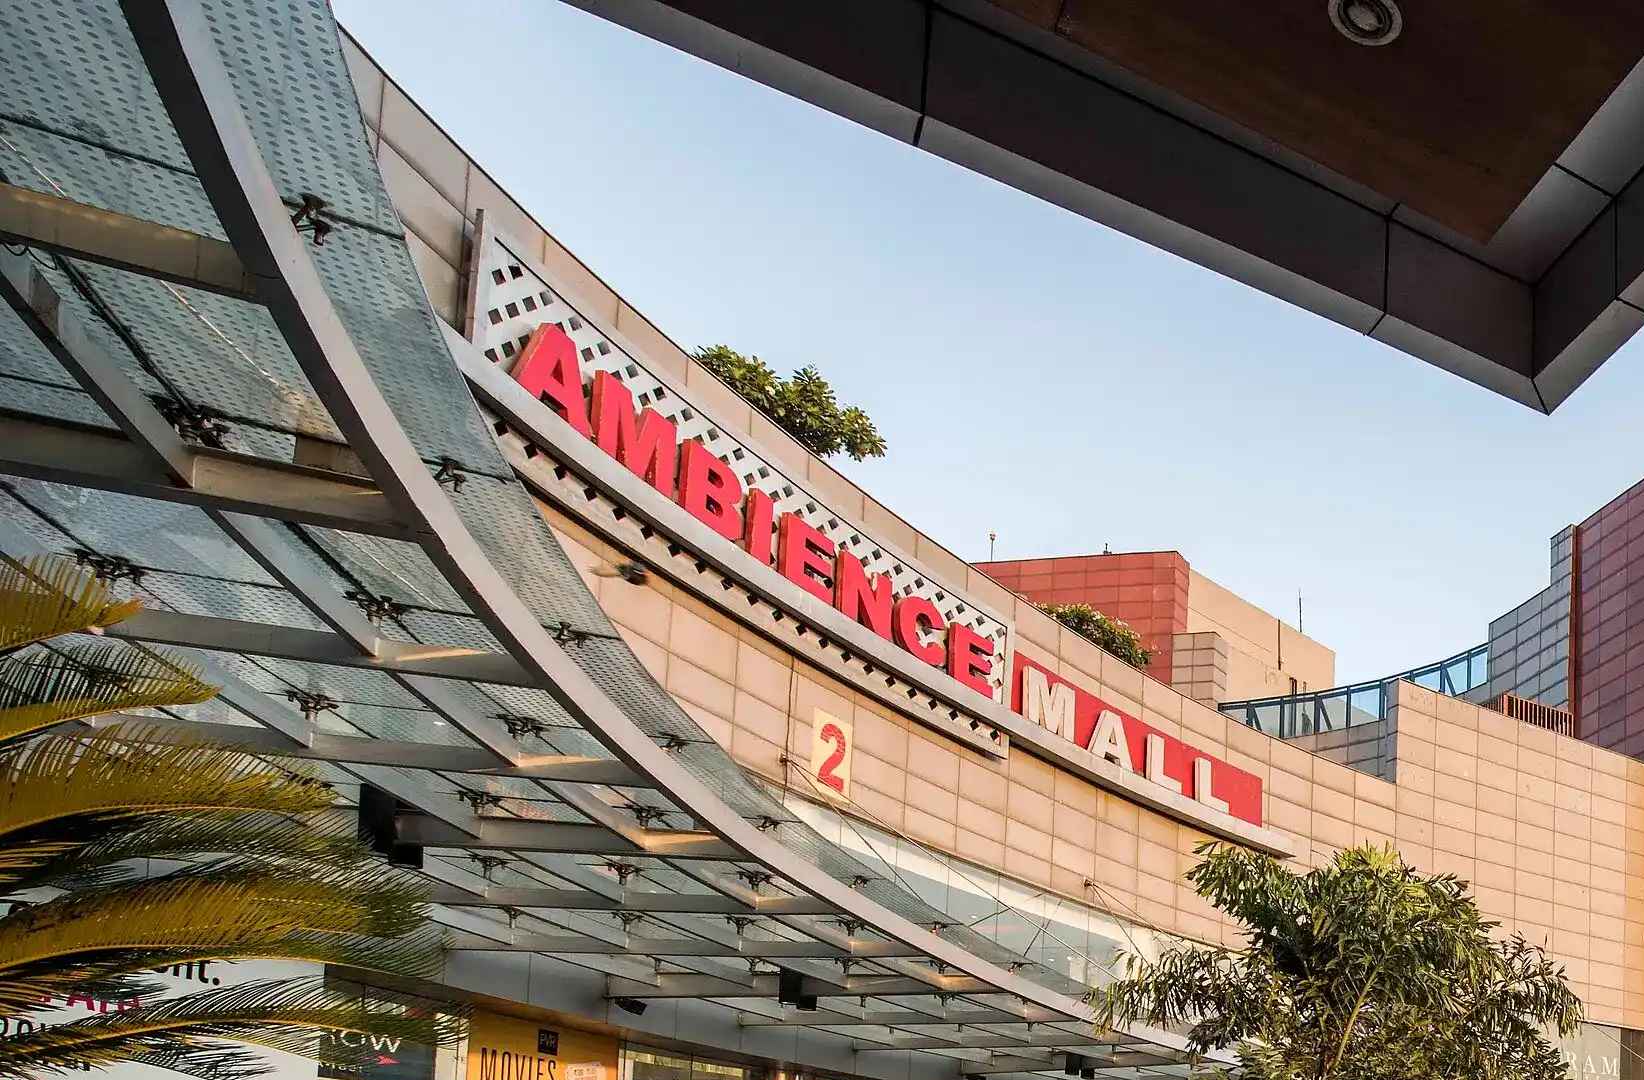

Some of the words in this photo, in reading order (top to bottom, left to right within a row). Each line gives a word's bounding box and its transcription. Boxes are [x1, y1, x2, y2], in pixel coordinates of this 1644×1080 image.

[508, 322, 994, 700] AMBIENCE
[1022, 664, 1230, 816] MALL
[816, 722, 847, 793] 2
